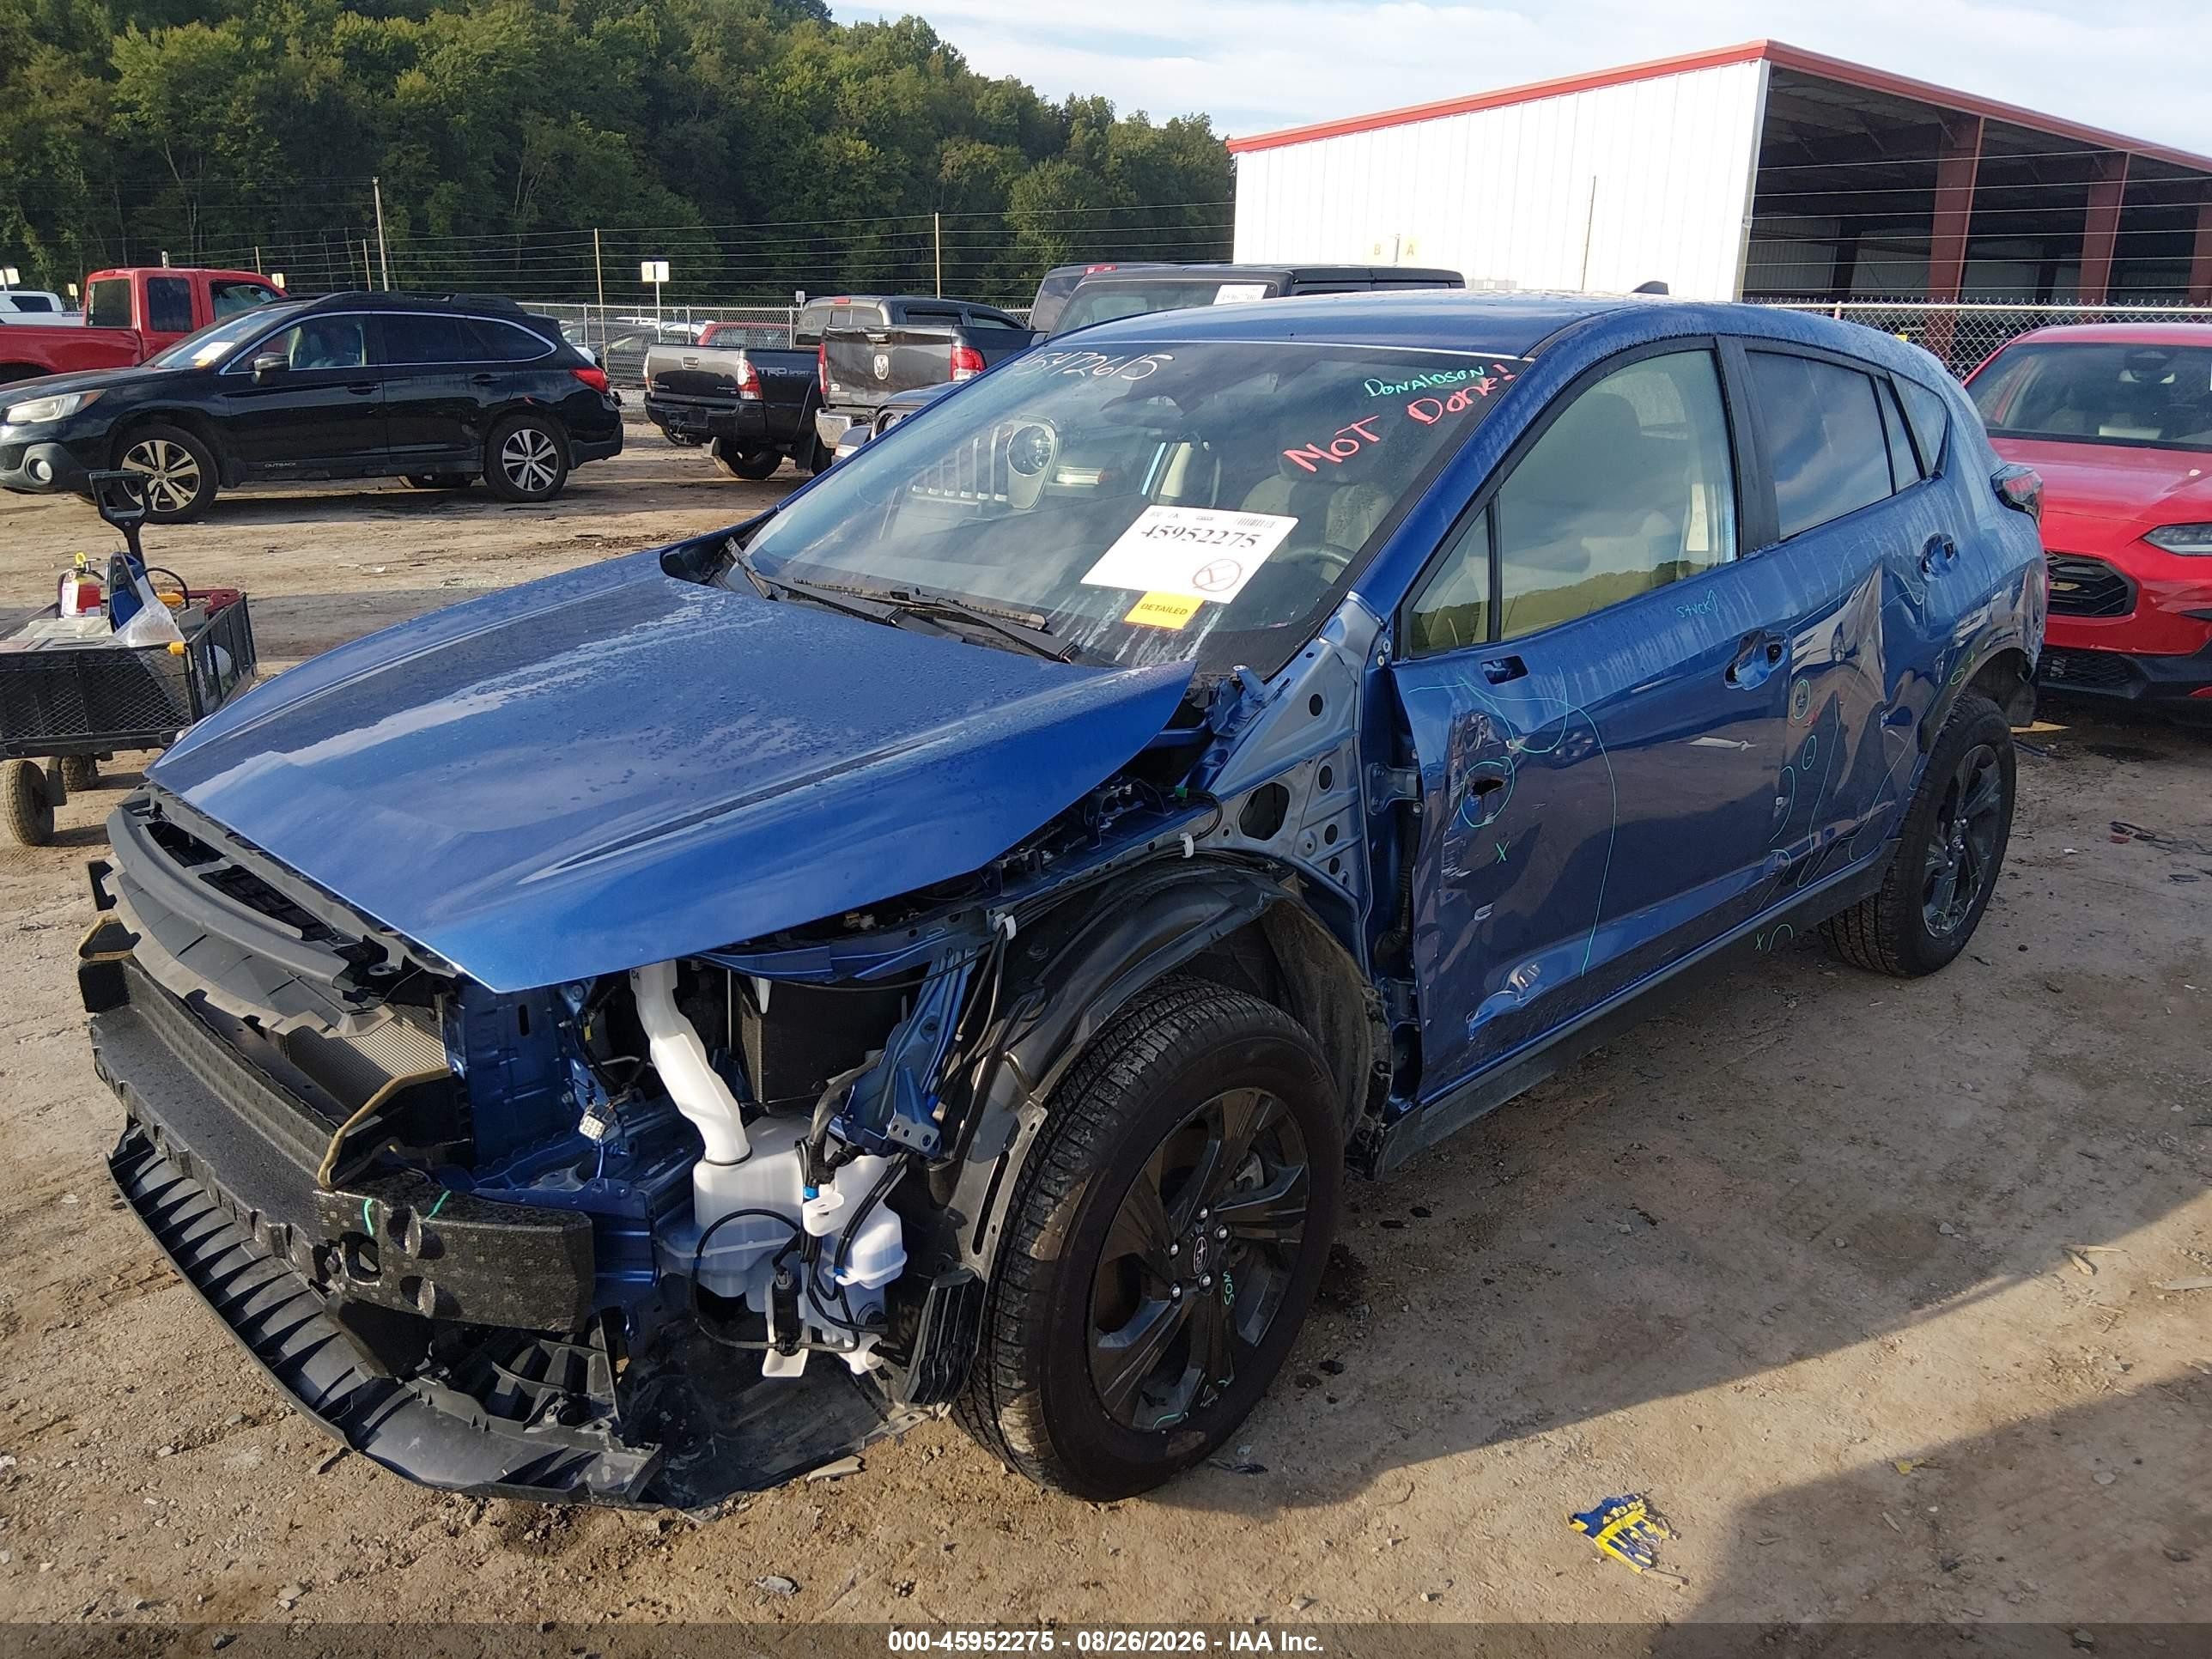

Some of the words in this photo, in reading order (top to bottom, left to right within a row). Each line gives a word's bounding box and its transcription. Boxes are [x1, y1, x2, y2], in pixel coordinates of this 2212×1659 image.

[757, 367, 787, 376] TRD
[1283, 415, 1381, 473] NOT
[1140, 523, 1262, 548] 45952275
[1140, 603, 1188, 616] DETAILED
